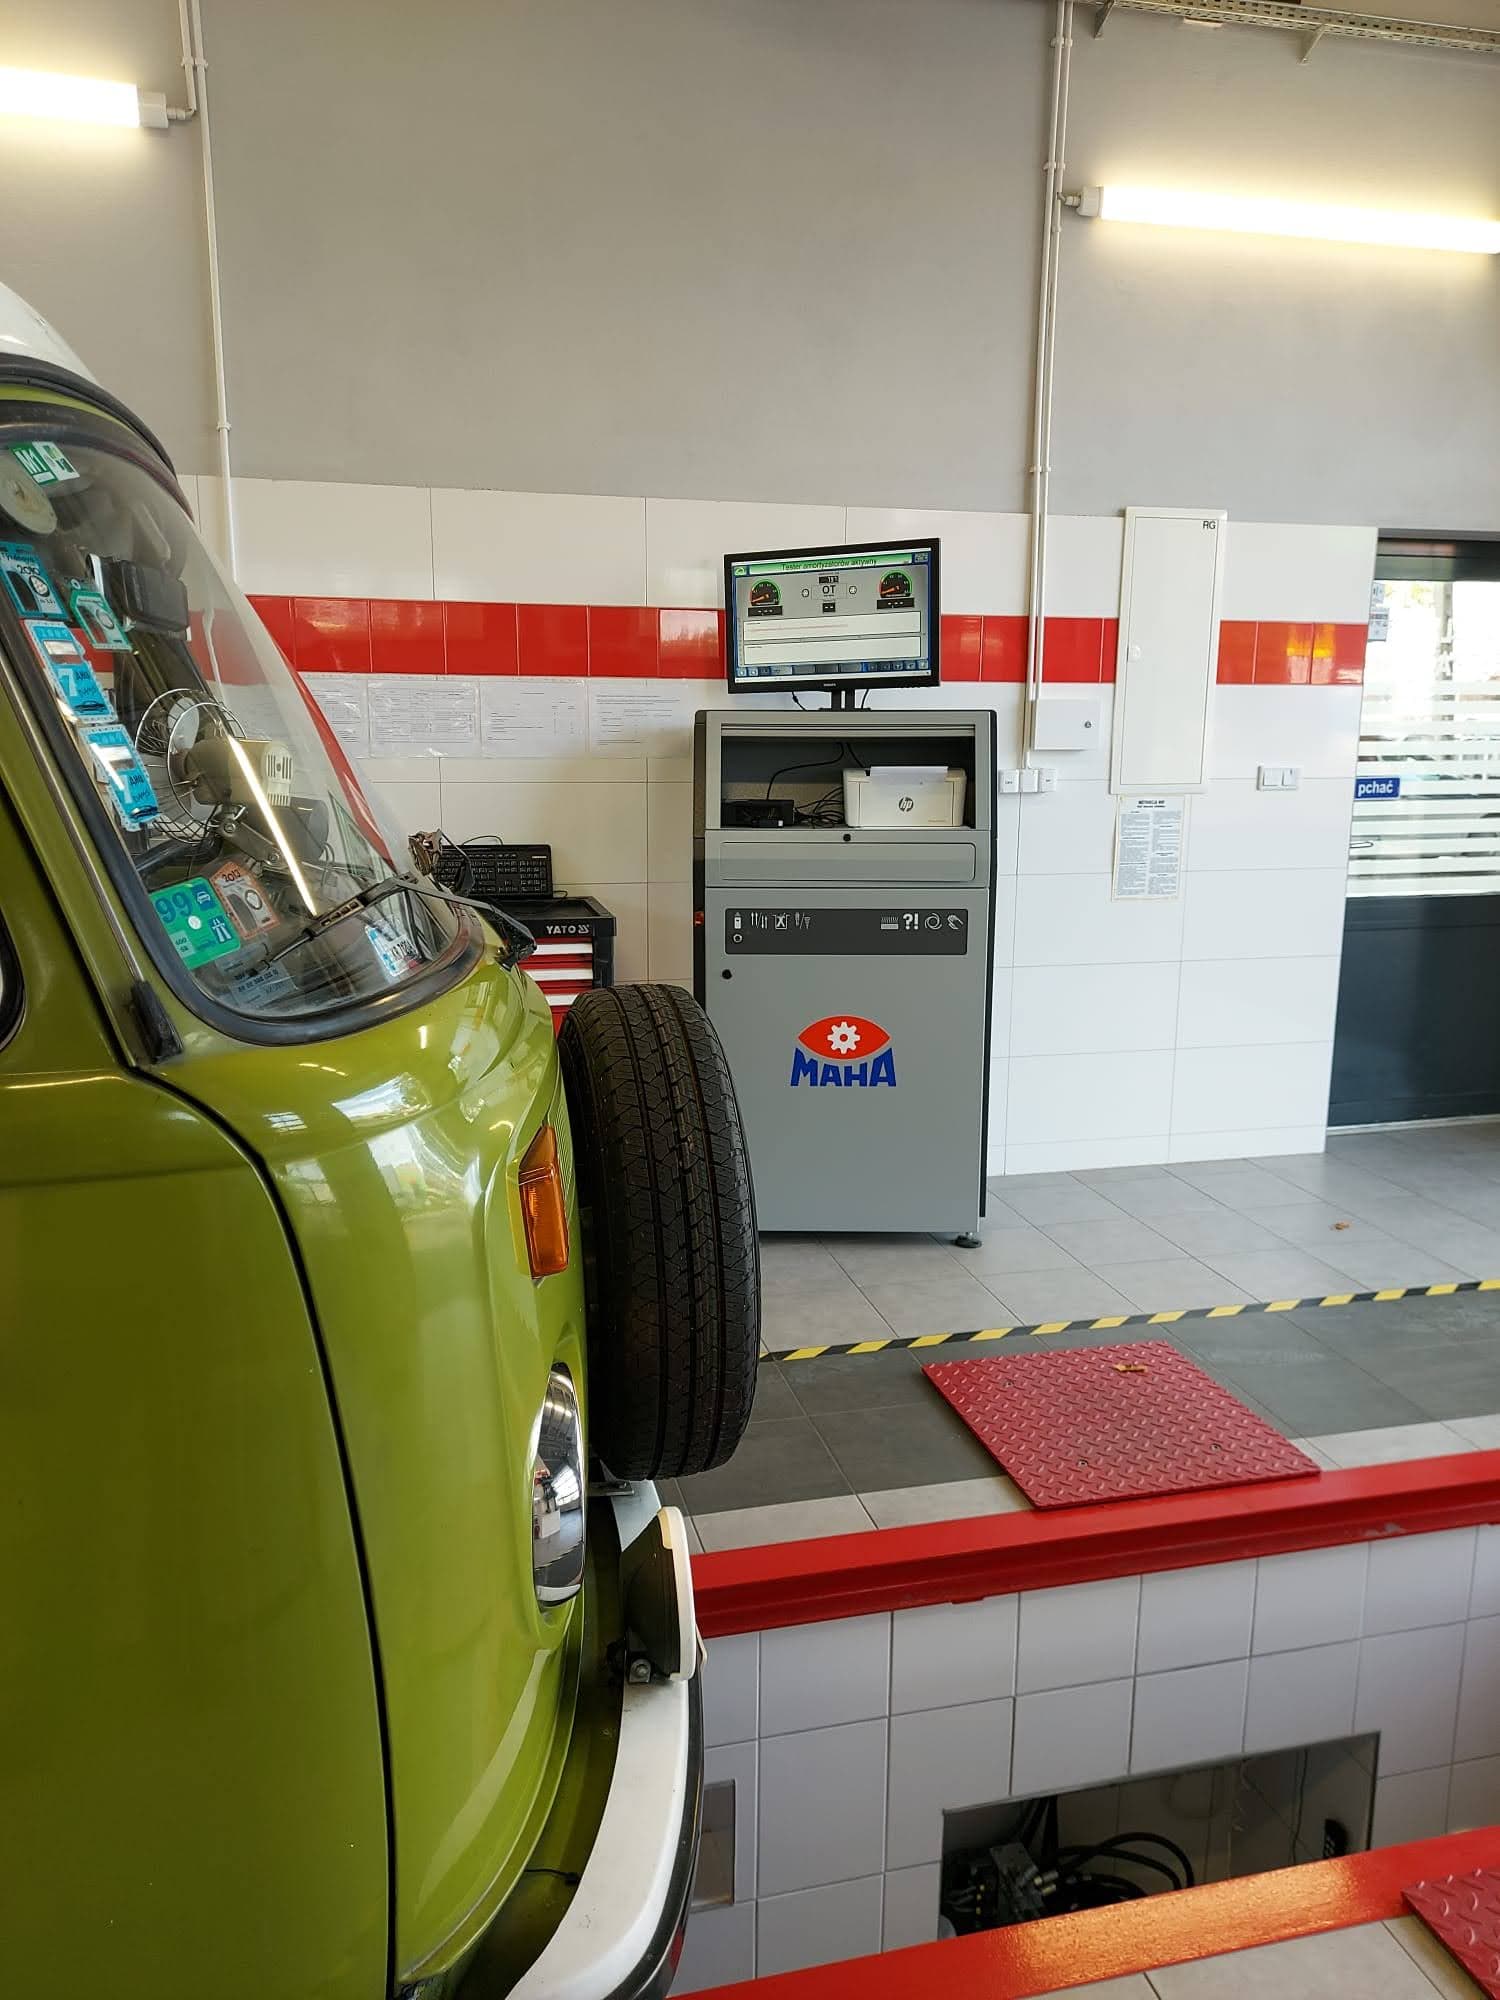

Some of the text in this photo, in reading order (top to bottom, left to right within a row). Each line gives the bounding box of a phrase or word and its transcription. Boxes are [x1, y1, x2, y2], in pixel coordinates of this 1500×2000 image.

[1203, 521, 1216, 529] RG
[782, 563, 801, 571] Tester
[822, 585, 836, 594] OT
[1358, 780, 1394, 797] pchać
[221, 869, 241, 882] 2013
[155, 891, 193, 924] 99
[546, 925, 576, 934] YATO
[790, 1047, 897, 1087] MAHA
